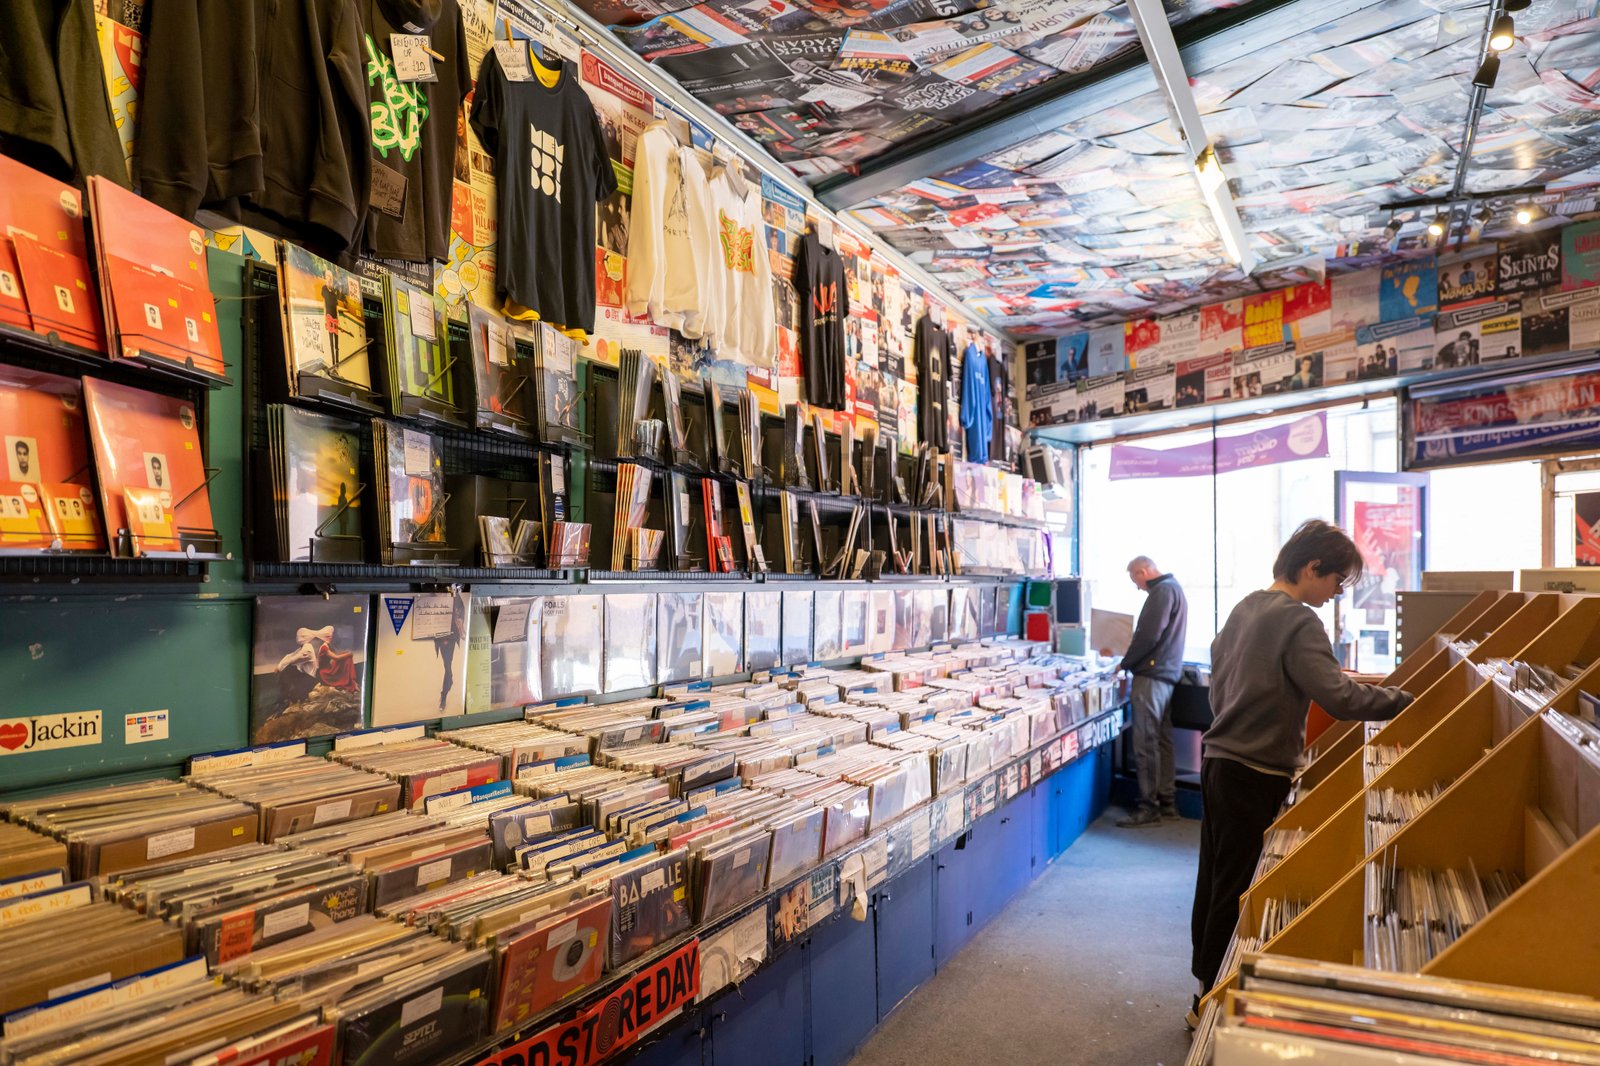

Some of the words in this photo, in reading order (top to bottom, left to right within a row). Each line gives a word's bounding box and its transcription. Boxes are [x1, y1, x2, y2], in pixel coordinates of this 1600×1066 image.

[523, 11, 544, 32] records
[603, 70, 624, 91] banquet
[623, 83, 643, 101] records
[364, 262, 377, 272] THE
[1499, 244, 1560, 279] SKINTS
[1439, 280, 1496, 301] WOMBATS
[1482, 318, 1518, 331] example
[1207, 364, 1232, 379] suede
[543, 600, 566, 610] FOALS
[24, 714, 100, 750] Jackin'
[472, 786, 511, 803] @BanquetRecords
[329, 905, 356, 922] Thang
[656, 946, 698, 1015] DAY
[402, 1020, 438, 1046] SEPTET
